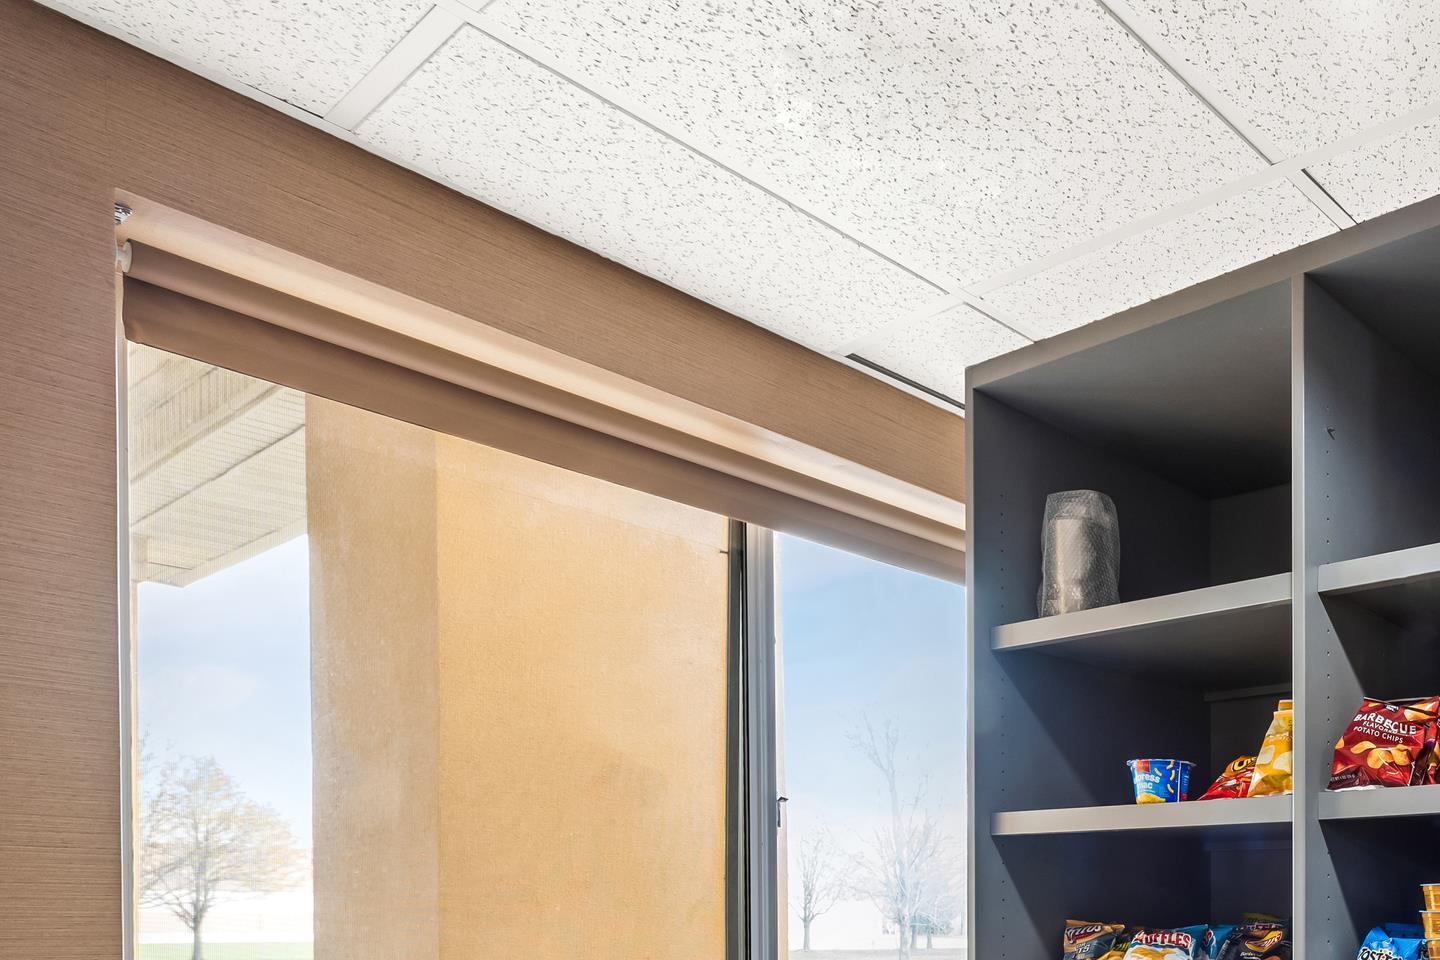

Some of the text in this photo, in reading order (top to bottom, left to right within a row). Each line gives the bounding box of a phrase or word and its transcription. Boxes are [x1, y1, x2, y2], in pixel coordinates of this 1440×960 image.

[1353, 712, 1417, 735] BARBECUE
[1353, 725, 1404, 744] POTATO CHIPS
[1132, 930, 1191, 949] RUFFLES
